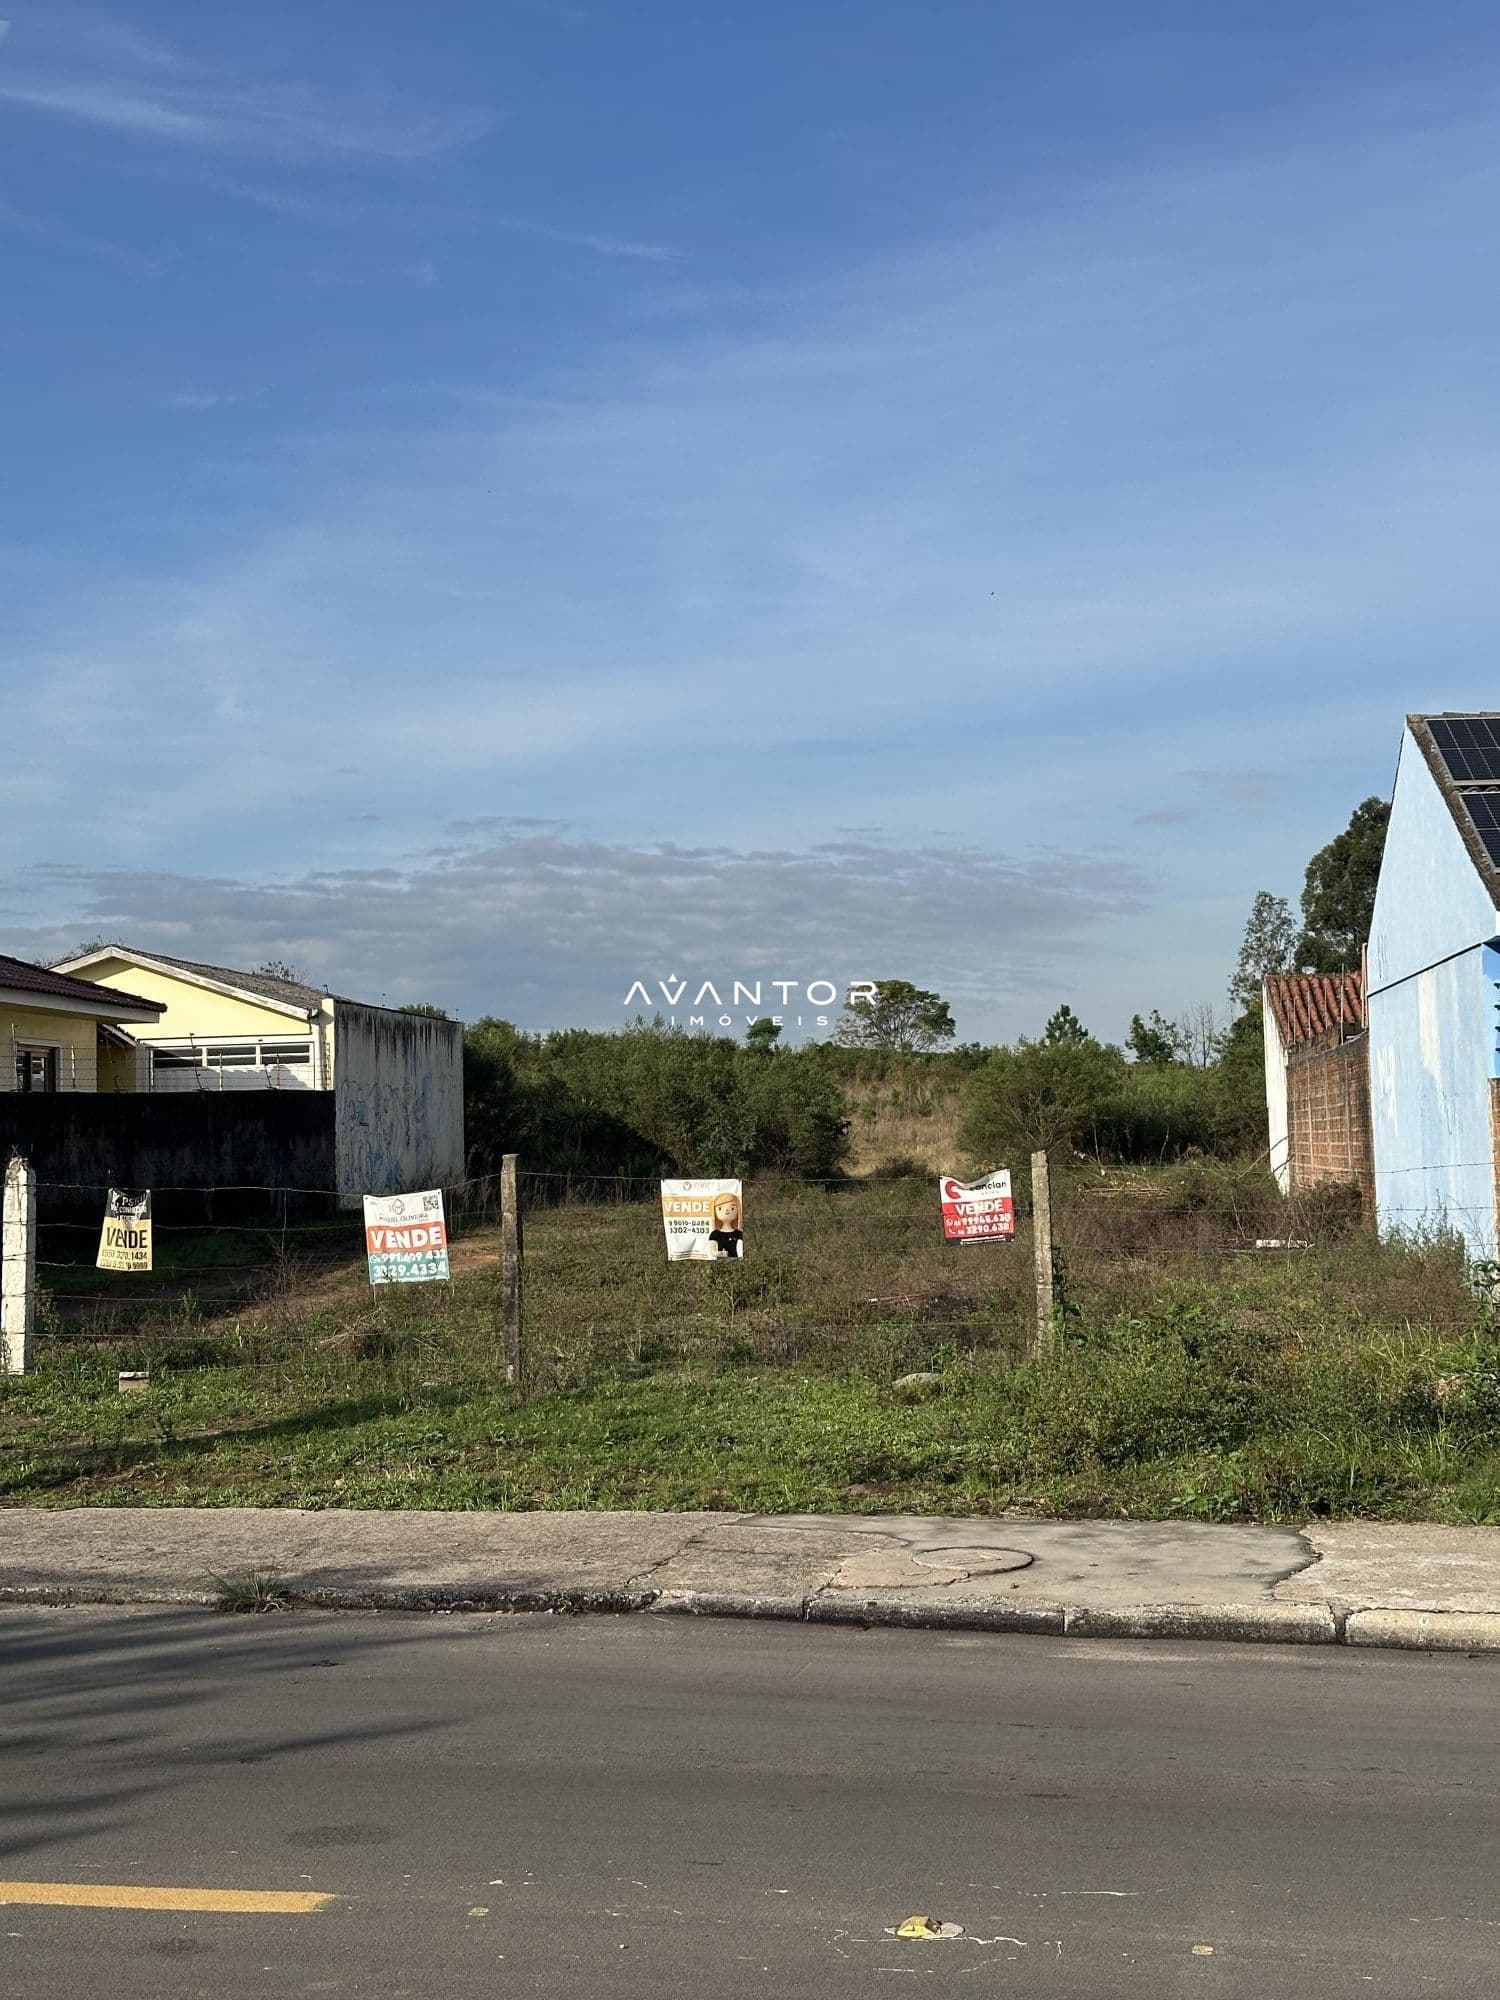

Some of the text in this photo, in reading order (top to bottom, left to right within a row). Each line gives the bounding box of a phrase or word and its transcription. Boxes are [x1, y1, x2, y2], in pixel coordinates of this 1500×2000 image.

[664, 1201, 711, 1213] VENDE
[954, 1199, 1004, 1216] VENDE
[106, 1226, 148, 1249] VENDE
[370, 1226, 443, 1249] VENDE
